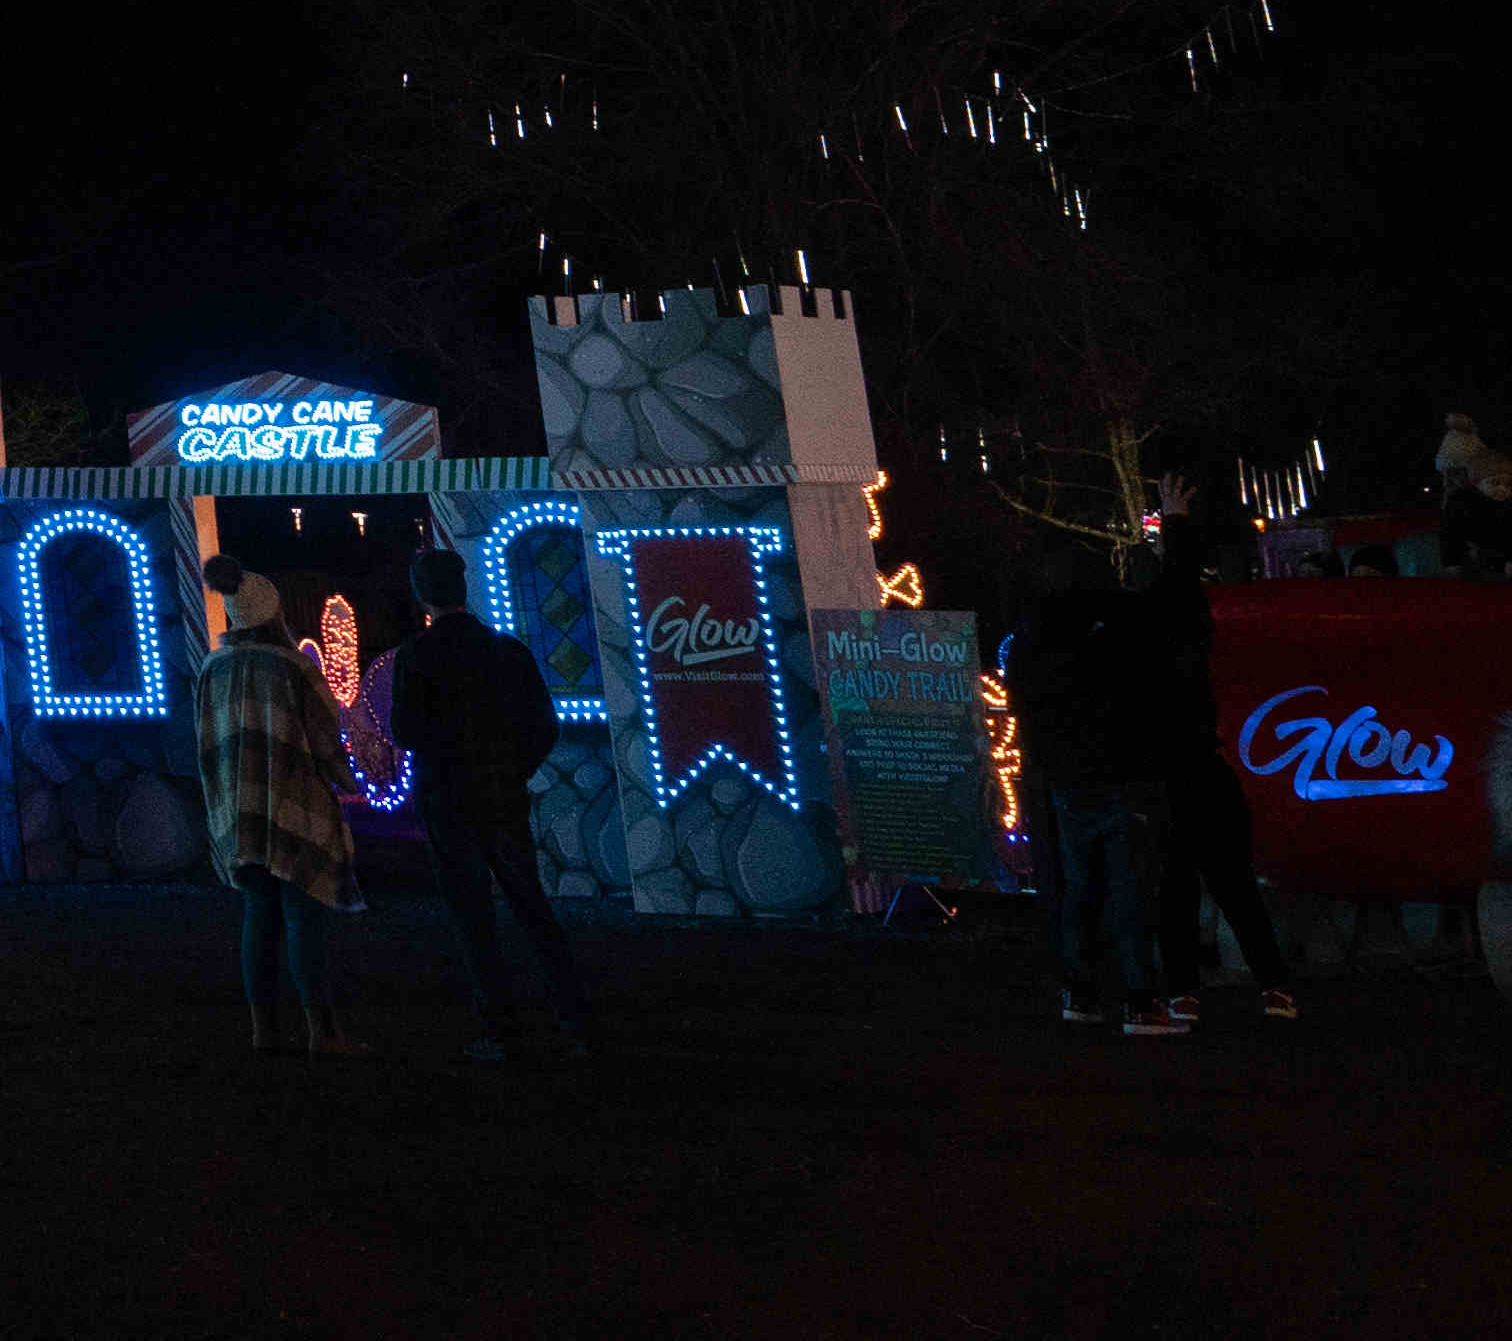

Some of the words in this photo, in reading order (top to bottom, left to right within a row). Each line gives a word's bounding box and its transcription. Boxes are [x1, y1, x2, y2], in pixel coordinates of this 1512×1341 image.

[181, 402, 284, 426] CANDY
[292, 400, 374, 423] CANE
[178, 424, 383, 461] CASTLE
[646, 595, 760, 665] Glow
[829, 669, 901, 701] CANDY
[906, 671, 975, 702] TRAIL
[1238, 685, 1455, 801] Glow
